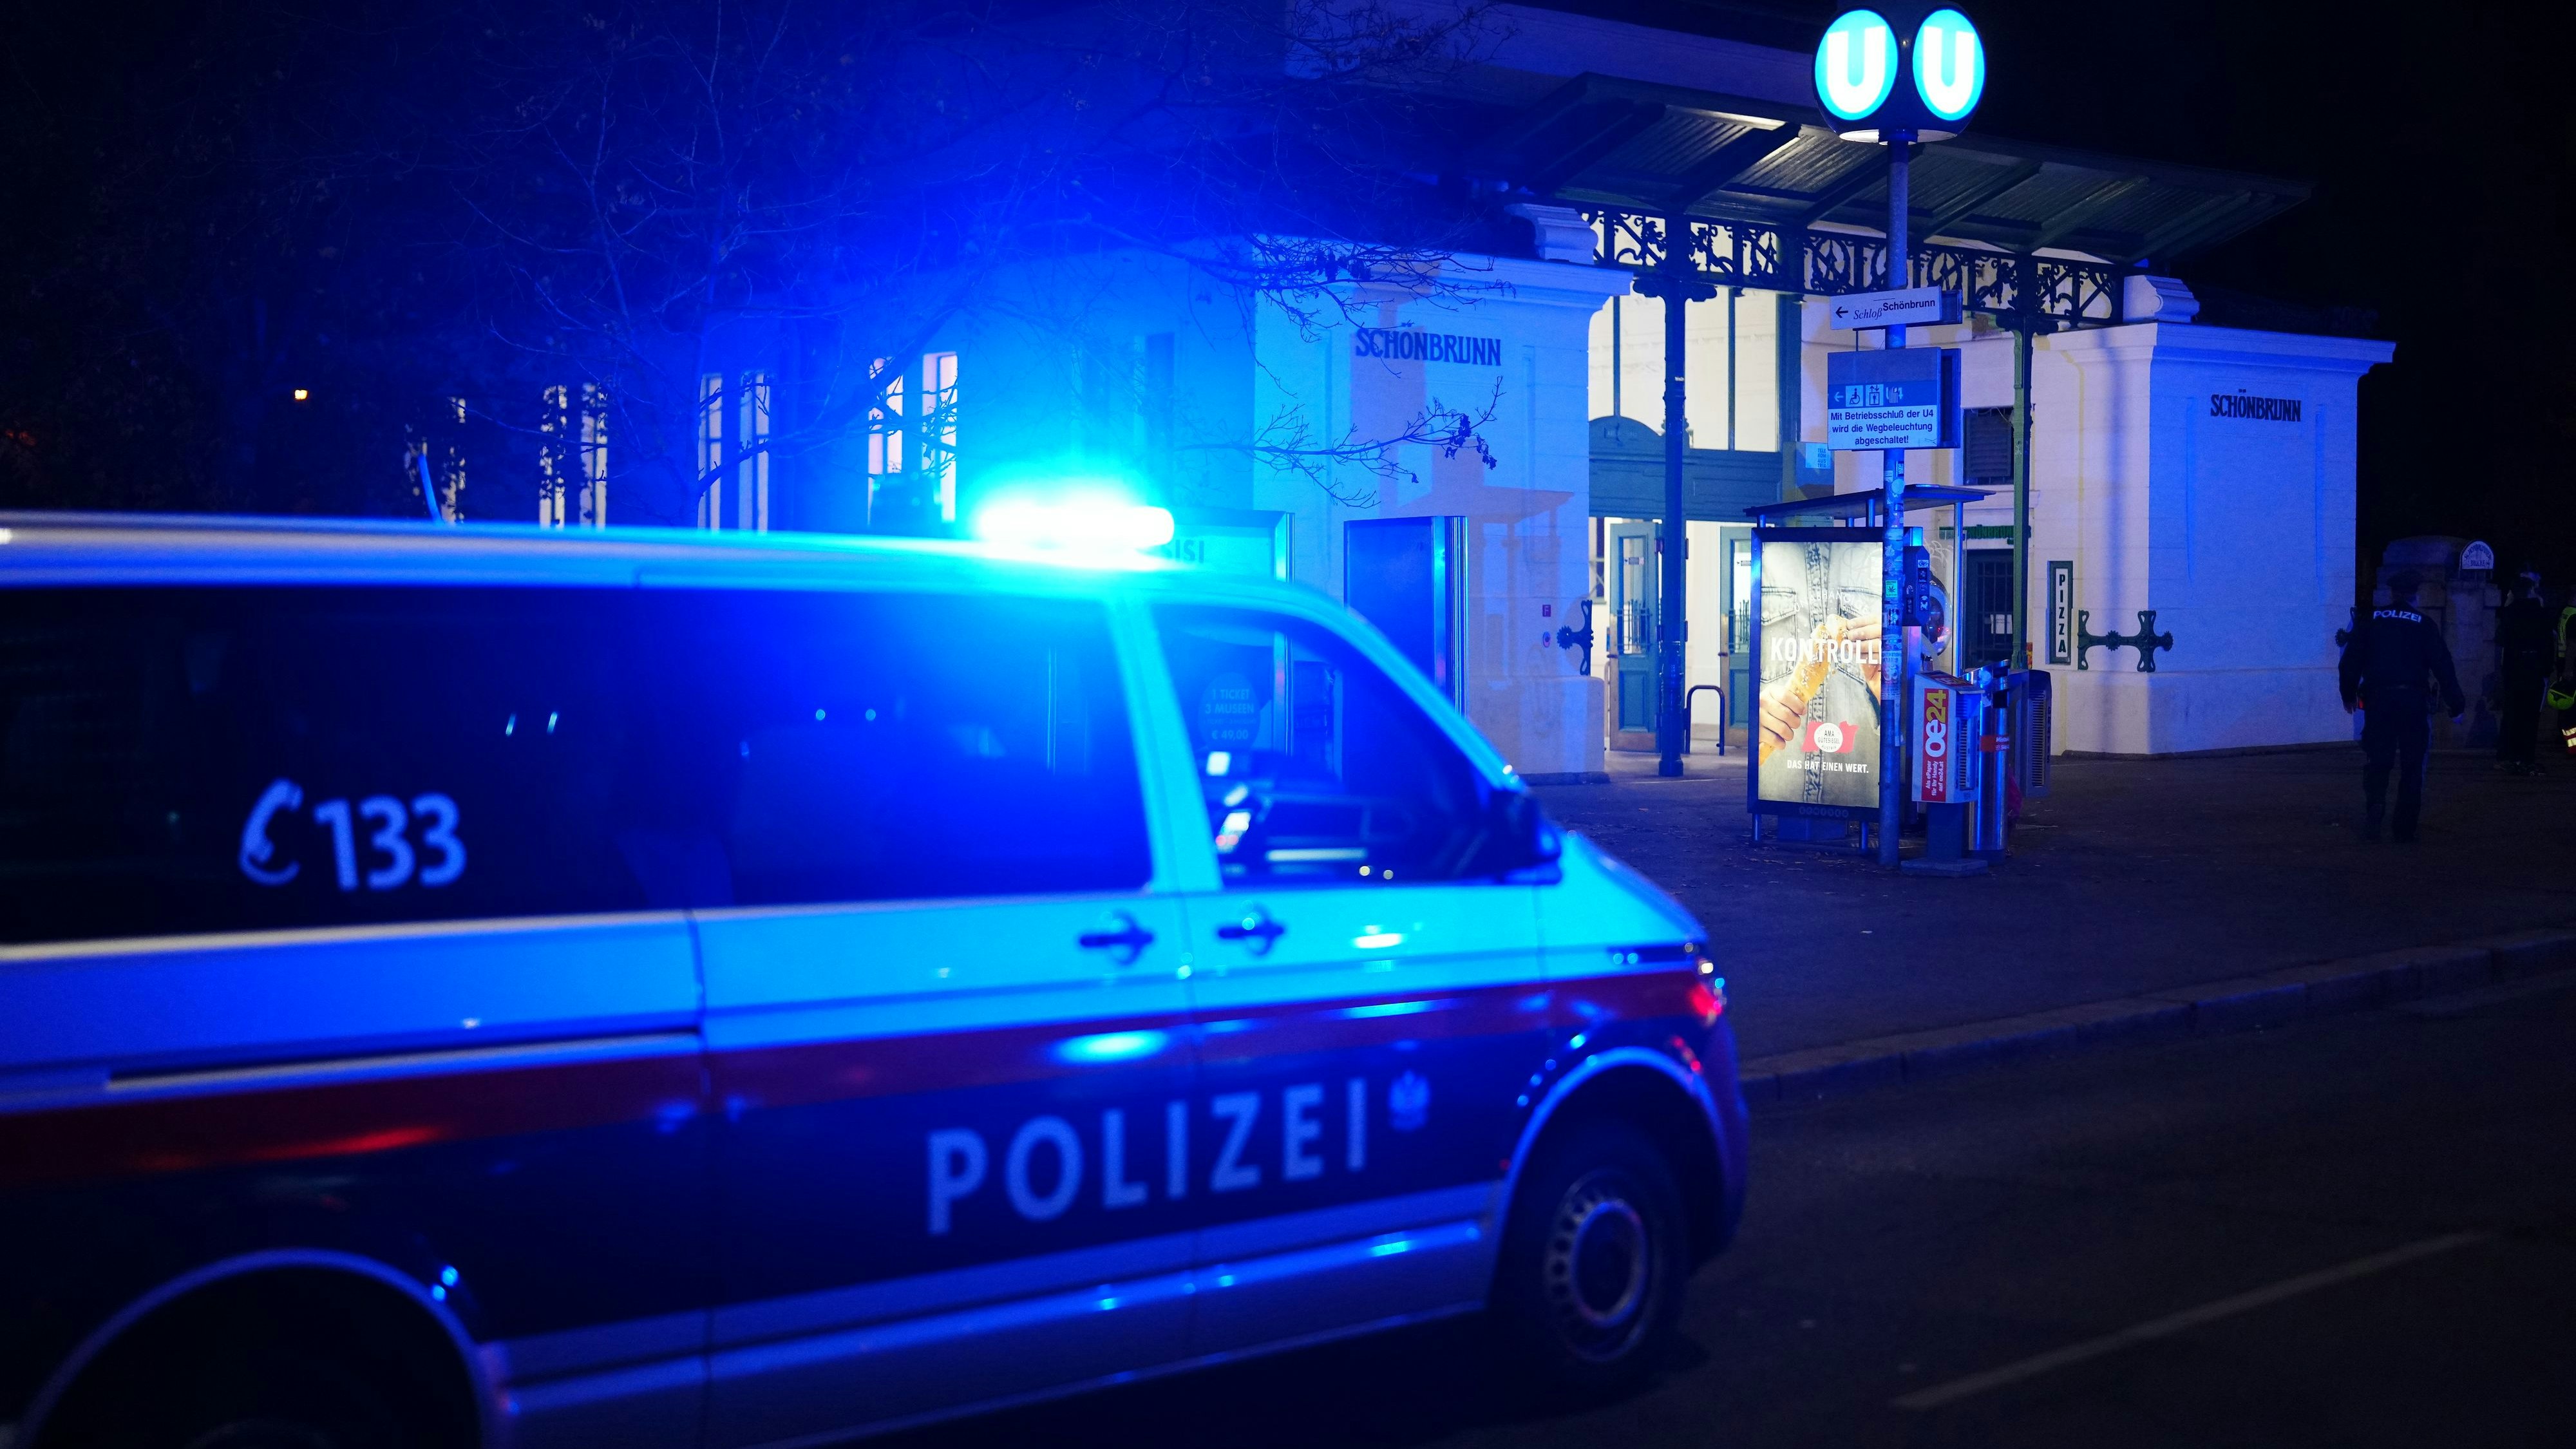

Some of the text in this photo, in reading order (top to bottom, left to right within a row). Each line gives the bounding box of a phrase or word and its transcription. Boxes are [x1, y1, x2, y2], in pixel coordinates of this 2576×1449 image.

[1828, 26, 1886, 113] U
[1924, 26, 1975, 113] U
[1853, 299, 1935, 319] Schloß Schönbrunn
[1356, 323, 1501, 366] SCHÖNBRUNN
[1830, 409, 1934, 421] Mit Betriebsschluß der U4
[2210, 388, 2302, 422] SCHÖNBRUNN
[1832, 422, 1932, 434] wird die Wegbeleuchtung
[1855, 435, 1909, 446] abgeschaltet!
[2058, 574, 2067, 652] PIZZA
[2373, 610, 2421, 623] POLIZEI
[1220, 688, 1250, 700] TICKET
[1205, 703, 1255, 714] 3 MUSEEN
[1926, 689, 1947, 757] oe24
[1221, 729, 1249, 741] 49,00
[1787, 759, 1869, 773] DAS HAT EINEN WERT.
[314, 793, 467, 891] 133
[926, 1077, 1367, 1236] POLIZEI
